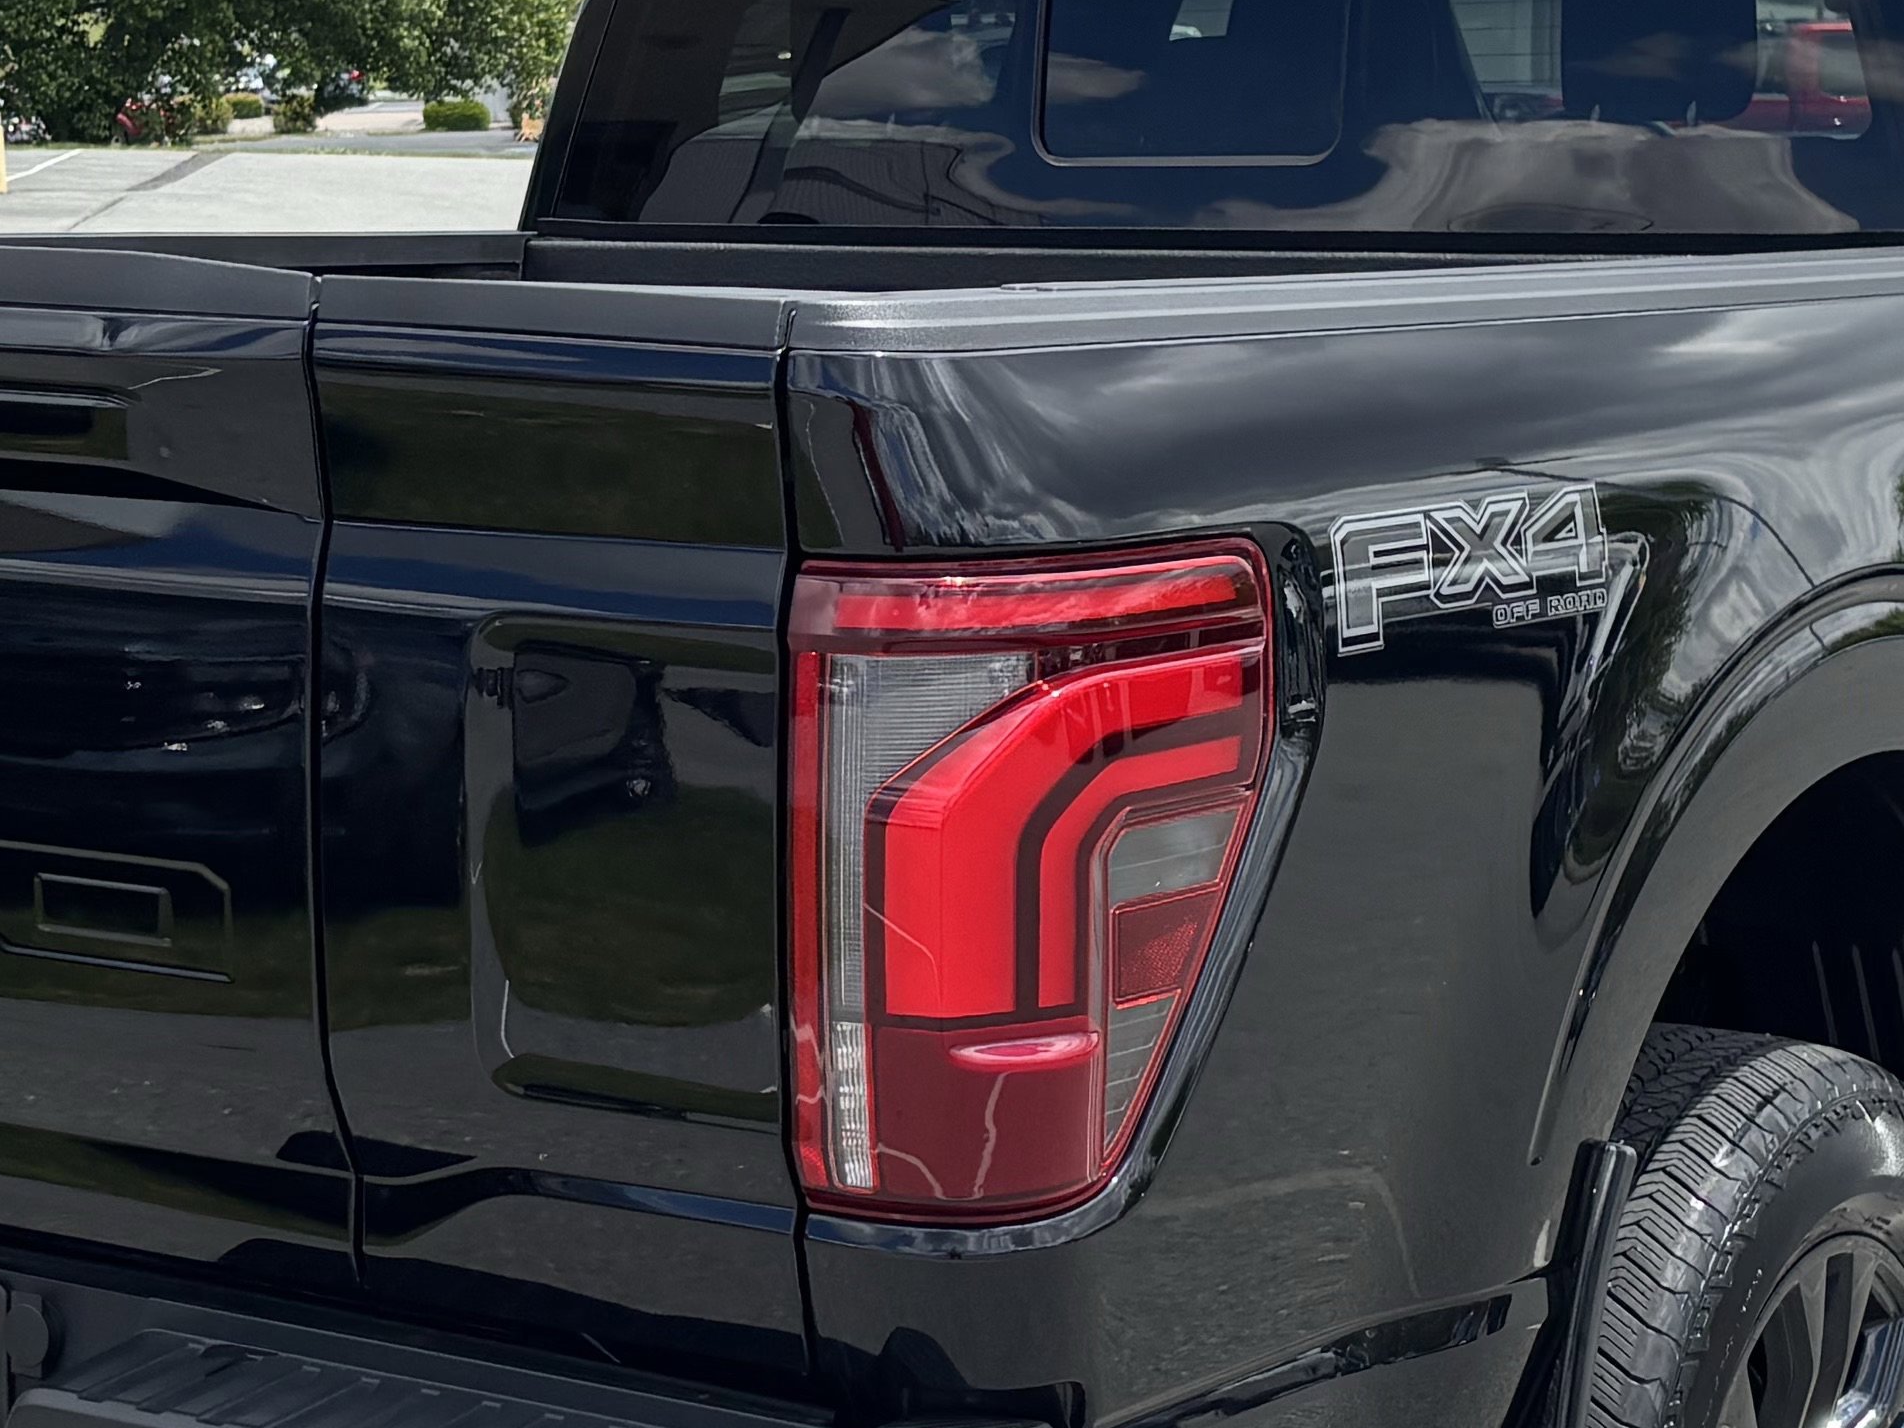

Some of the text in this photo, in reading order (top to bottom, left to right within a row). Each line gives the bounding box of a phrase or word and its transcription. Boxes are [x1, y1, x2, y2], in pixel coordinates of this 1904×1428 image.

[1328, 483, 1609, 657] FX4
[1493, 587, 1608, 628] OFF ROAD
